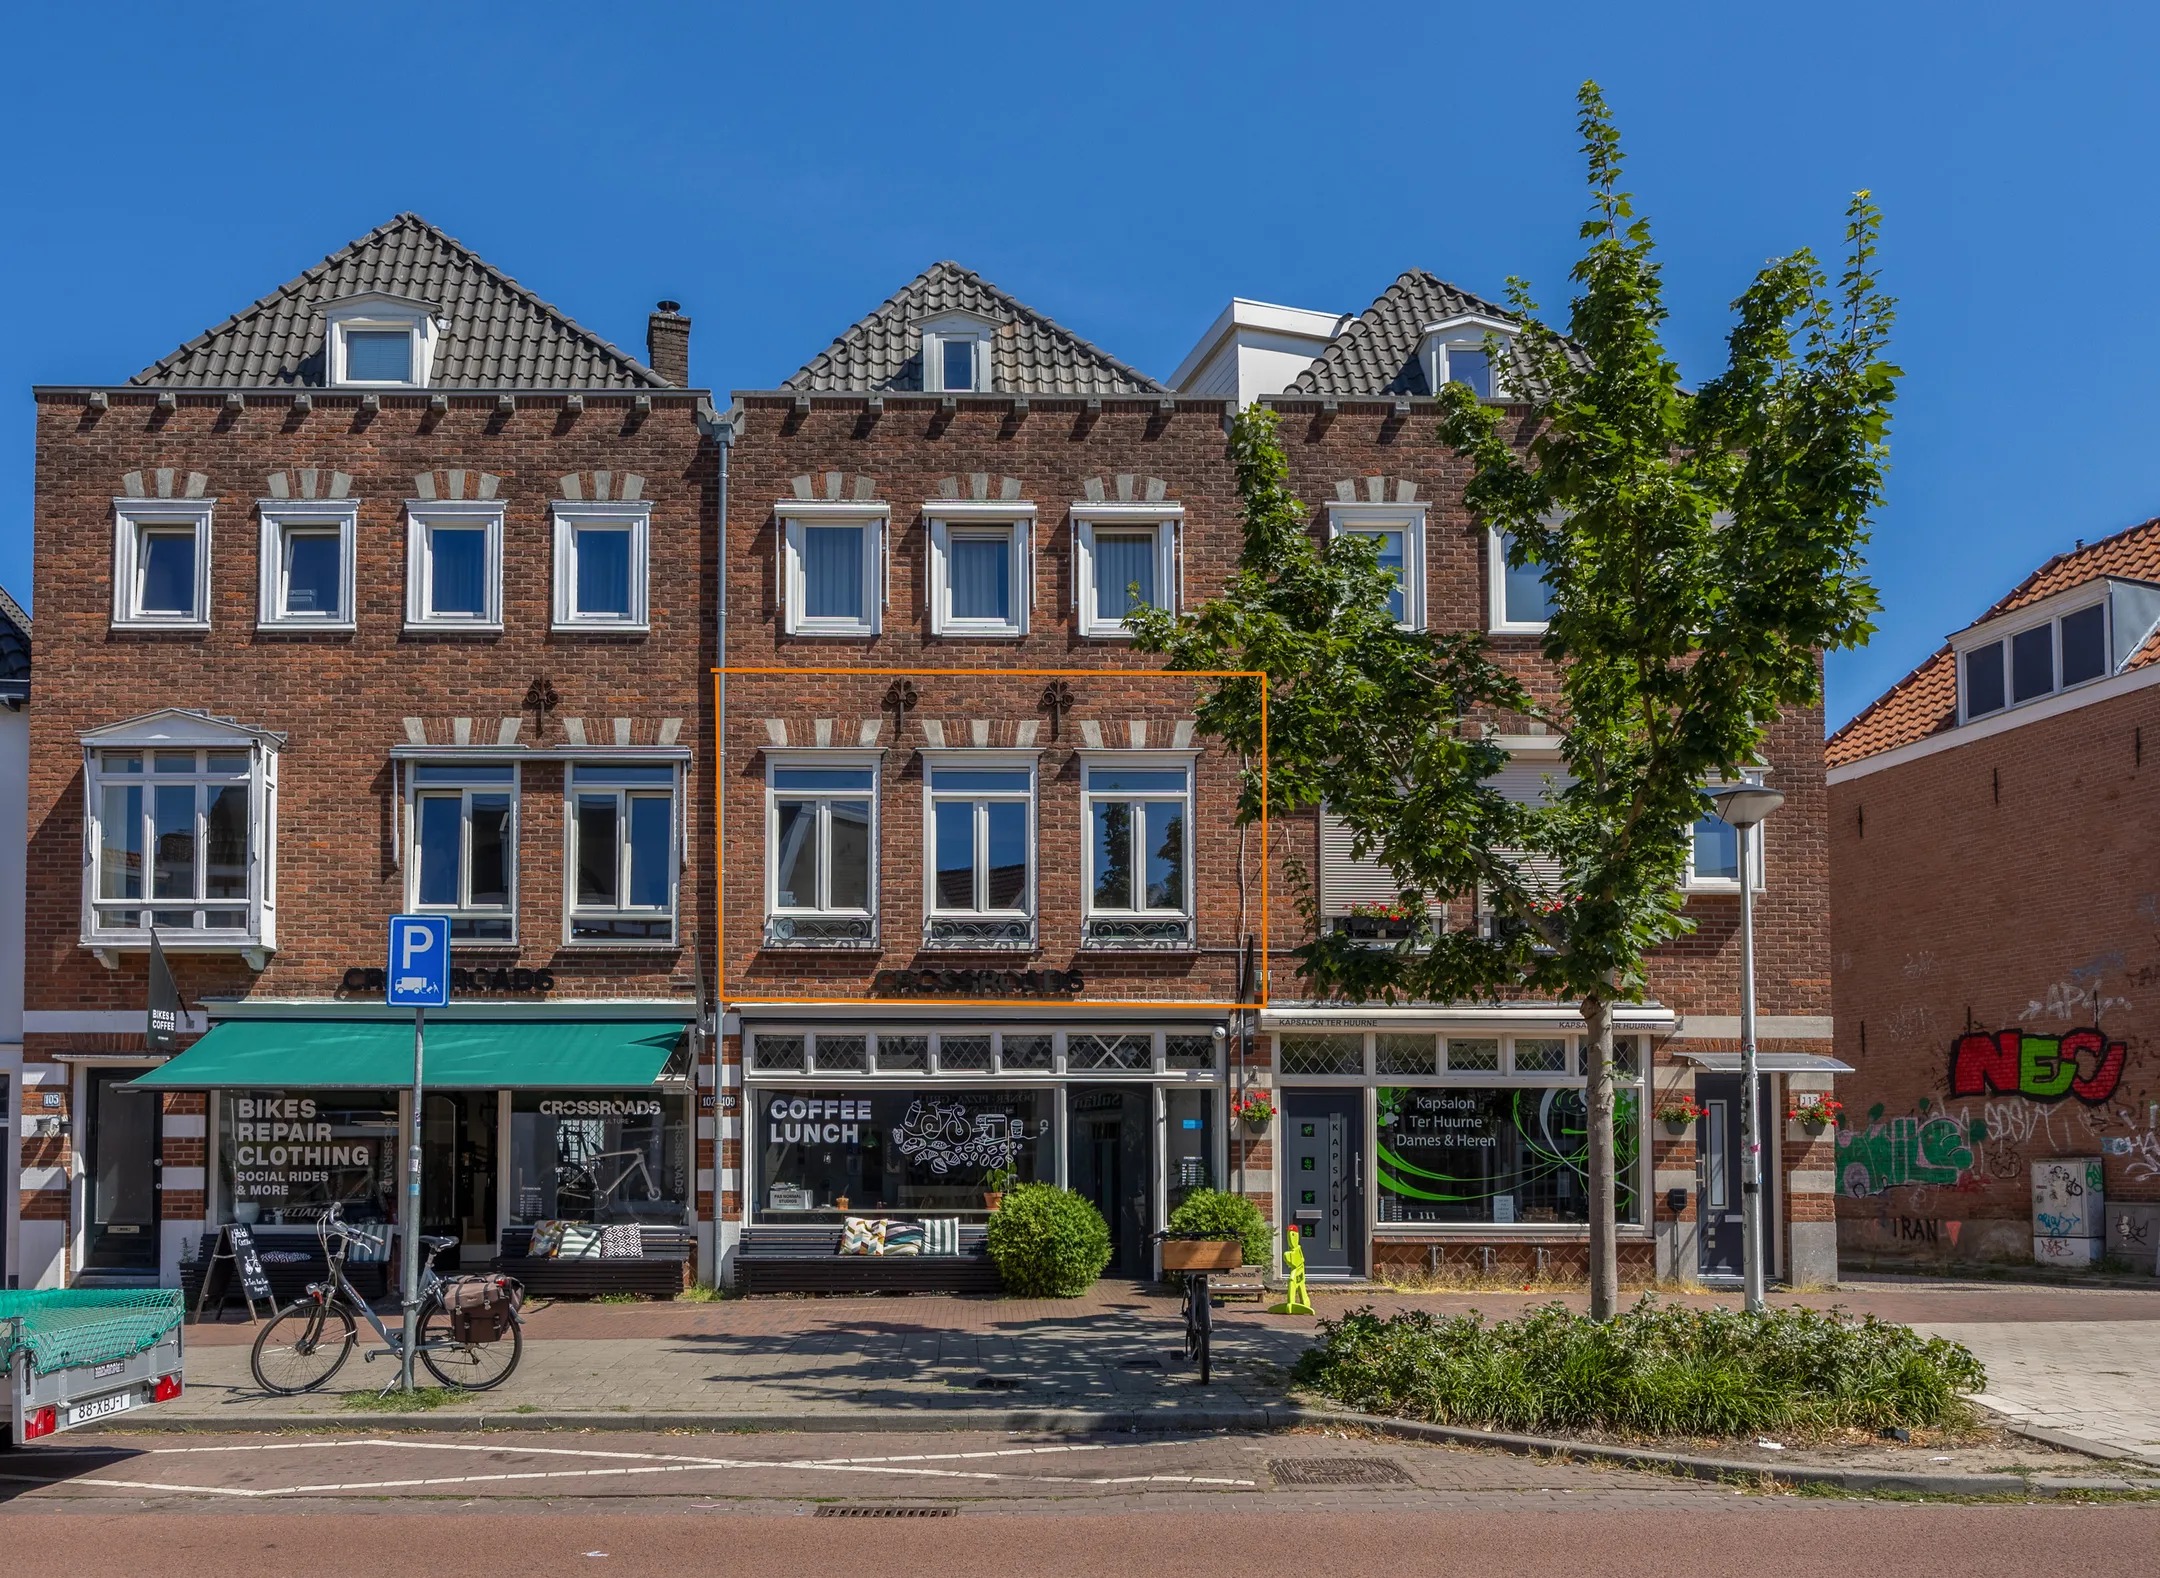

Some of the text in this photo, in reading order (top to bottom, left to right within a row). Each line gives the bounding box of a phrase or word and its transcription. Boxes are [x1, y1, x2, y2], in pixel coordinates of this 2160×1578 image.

[402, 925, 434, 969] P
[343, 968, 554, 991] CRROADS
[152, 1009, 170, 1021] BIKES
[152, 1020, 175, 1031] COFFEE
[1344, 1019, 1378, 1027] HUURNE
[1560, 1021, 1587, 1029] KAPSA
[1623, 1022, 1657, 1030] HUURNE
[44, 1094, 59, 1105] 105
[722, 1096, 736, 1107] 109
[1416, 1097, 1475, 1112] Kapsalon
[238, 1099, 317, 1119] BIKES
[539, 1100, 661, 1115] CROSSROADS
[770, 1100, 872, 1120] COFFEE
[1409, 1115, 1482, 1128] Ter Huurne
[238, 1122, 332, 1142] REPAIR
[770, 1123, 859, 1144] LUNCH
[1396, 1134, 1496, 1147] Dames & Heren
[237, 1146, 369, 1166] CLOTHING
[237, 1171, 329, 1182] SOCIAL RIDES
[1331, 1123, 1340, 1232] KAPSALON
[236, 1184, 289, 1196] & MORE
